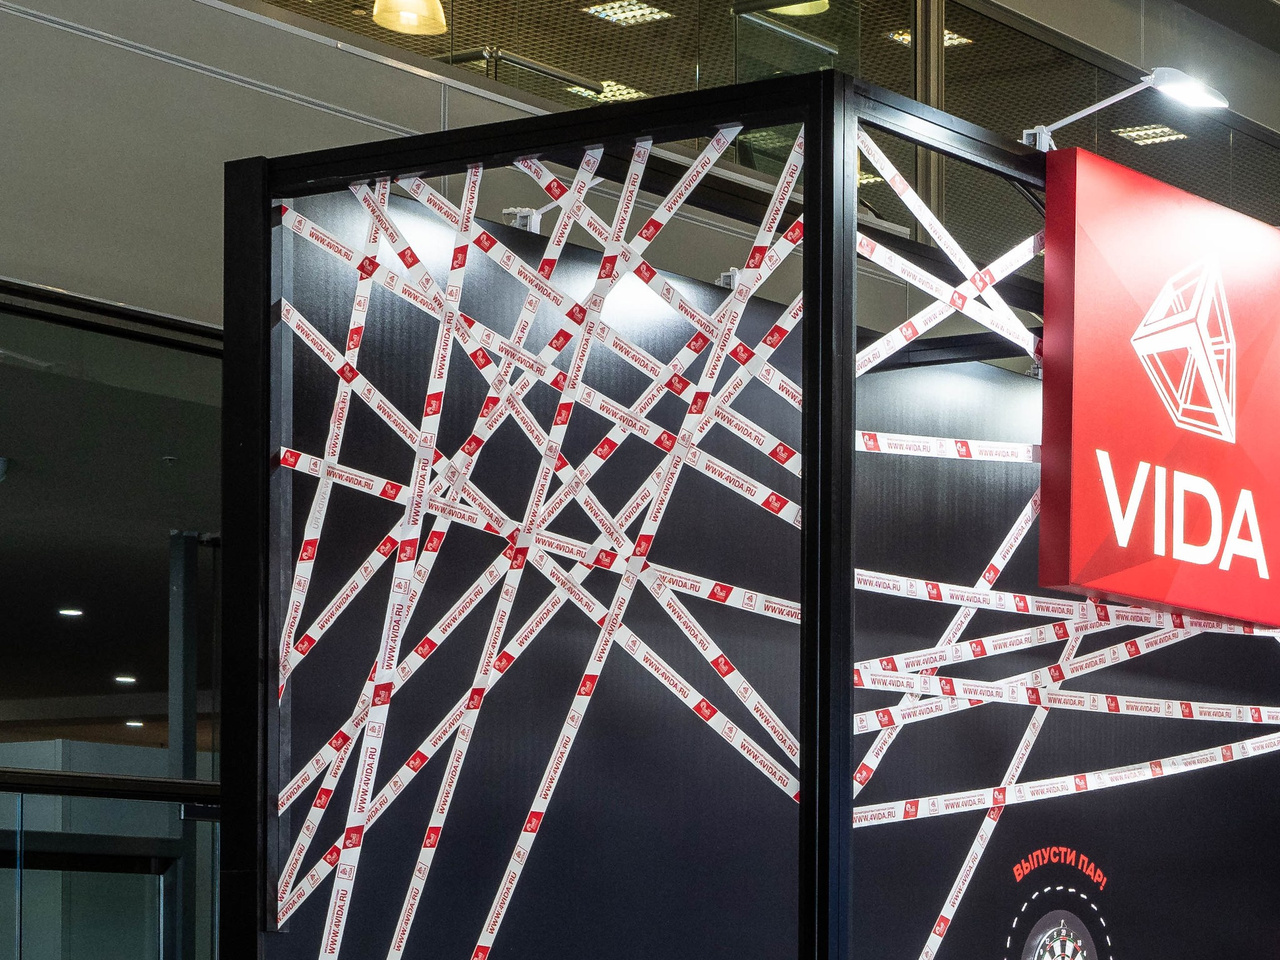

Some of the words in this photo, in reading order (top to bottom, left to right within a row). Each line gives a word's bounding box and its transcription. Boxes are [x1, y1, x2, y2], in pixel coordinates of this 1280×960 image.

[666, 157, 710, 213] WWW.4VIDA.RU
[766, 164, 798, 233] WWW.4VIDA.RU
[363, 195, 397, 244] WWW.4VIDA.RU
[614, 173, 639, 242] WWW.4VIDA.RU
[309, 230, 353, 261] WWW.4VIDA.RU
[517, 268, 563, 307] WWW.4VIDA.RU
[295, 322, 335, 363] WWW.4VIDA.RU
[499, 343, 546, 377] WWW.4VIDA.RU
[612, 340, 660, 377] WWW.4VIDA.RU
[330, 391, 348, 457] WWW.4VIDA.RU
[376, 402, 417, 444] WWW.4VIDA.RU
[507, 395, 544, 447] WWW.4VIDA.RU
[599, 403, 649, 436] WWW.4VIDA.RU
[714, 408, 764, 446] WWW.4VIDA.RU
[326, 468, 373, 490] WWW.4VIDA.RU
[411, 458, 429, 525] WWW.4VIDA.RU
[527, 468, 550, 534] WWW.4VIDA.RU
[652, 456, 682, 523] WWW.4VIDA.RU
[705, 463, 756, 497] WWW.4VIDA.RU
[428, 500, 478, 524] WWW.4VIDA.RU
[462, 485, 504, 528] WWW.4VIDA.RU
[584, 496, 623, 548] WWW.4VIDA.RU
[1096, 449, 1269, 580] VIDA
[535, 536, 587, 558] WWW.4VIDA.RU
[319, 583, 359, 630] WWW.4VIDA.RU
[550, 569, 594, 613] WWW.4VIDA.RU
[857, 577, 900, 592] WWW.4VIDA.RU
[949, 593, 990, 604] WWW.4VIDA.RU
[440, 587, 483, 634] WWW.4VIDA.RU
[518, 596, 561, 647] WWW.4VIDA.RU
[596, 598, 626, 663] WWW.4VIDA.RU
[666, 600, 708, 651] WWW.4VIDA.RU
[1036, 604, 1074, 615] WWW.4VIDA.RU
[1115, 614, 1151, 623] WWW.4VIDA.RU
[385, 603, 403, 670] WWW.4VIDA.RU
[482, 610, 506, 675] WWW.4VIDA.RU
[643, 654, 689, 699] WWW.4VIDA.RU
[905, 654, 946, 668] WWW.4VIDA.RU
[1070, 657, 1106, 673] WWW.4VIDA.RU
[871, 678, 914, 689] WWW.4VIDA.RU
[963, 687, 1003, 698] WWW.4VIDA.RU
[1048, 696, 1084, 707] WWW.4VIDA.RU
[753, 704, 797, 756] WWW.4VIDA.RU
[901, 704, 943, 720] WWW.4VIDA.RU
[1126, 704, 1160, 714] WWW.4VIDA.RU
[1199, 710, 1231, 718] WWW.4VIDA.RU
[357, 747, 376, 813] WWW.4VIDA.RU
[439, 750, 462, 814] WWW.4VIDA.RU
[542, 736, 571, 800] WWW.4VIDA.RU
[740, 741, 788, 787] WWW.4VIDA.RU
[944, 798, 986, 810] WWW.4VIDA.RU
[951, 853, 979, 908] WWW.4VIDA.RU
[1012, 847, 1077, 883] ВЫПУСТИ
[1078, 853, 1108, 891] ПАР!
[328, 889, 348, 954] WWW.4VIDA.RU
[396, 888, 420, 952] WWW.4VIDA.RU
[489, 872, 517, 934] WWW.4VIDA.RU
